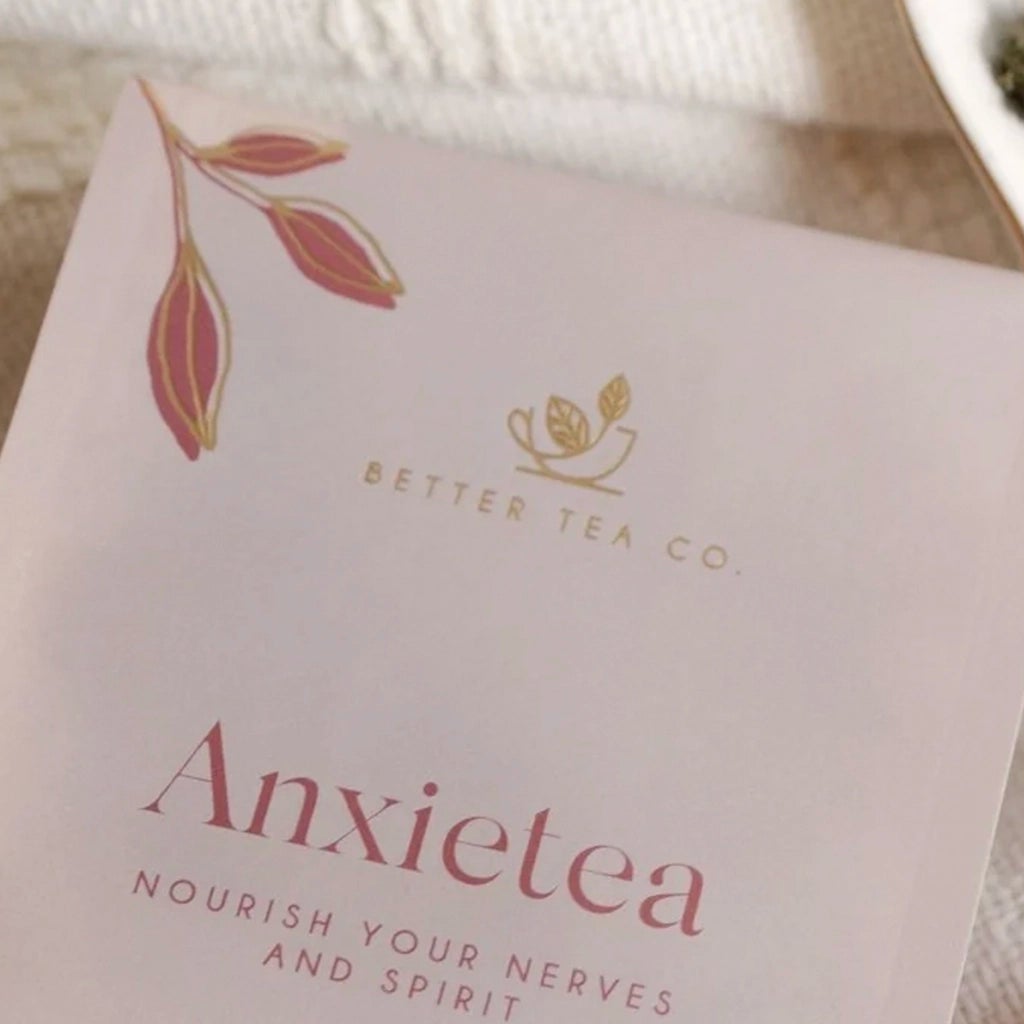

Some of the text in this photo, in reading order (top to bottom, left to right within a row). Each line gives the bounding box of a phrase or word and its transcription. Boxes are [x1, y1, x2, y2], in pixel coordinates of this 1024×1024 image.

[364, 461, 741, 575] BETTER TEA CO.
[139, 718, 705, 937] Anxietea
[132, 869, 672, 1017] NOURISH YOUR NERVES
[262, 942, 521, 1023] AND SPIRIT
